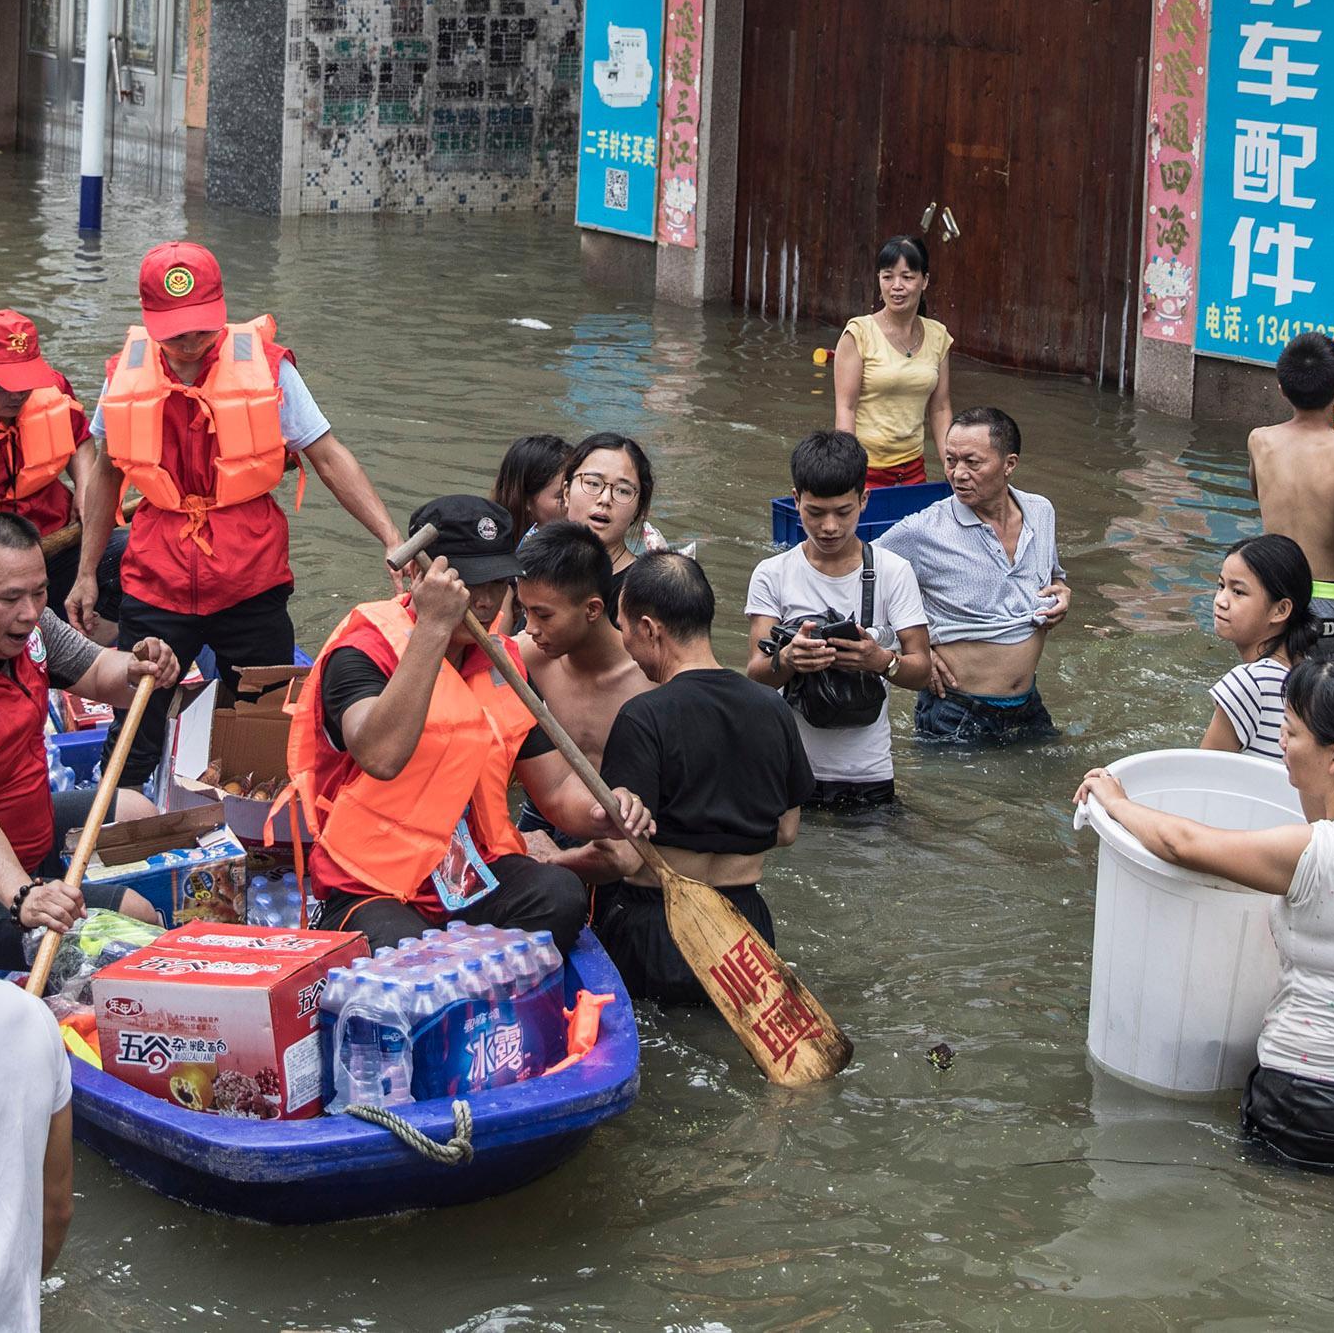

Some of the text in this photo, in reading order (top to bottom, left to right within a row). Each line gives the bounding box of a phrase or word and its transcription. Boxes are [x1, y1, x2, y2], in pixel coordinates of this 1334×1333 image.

[584, 129, 656, 168] 二手针车买卖
[466, 1023, 527, 1084] 冰露
